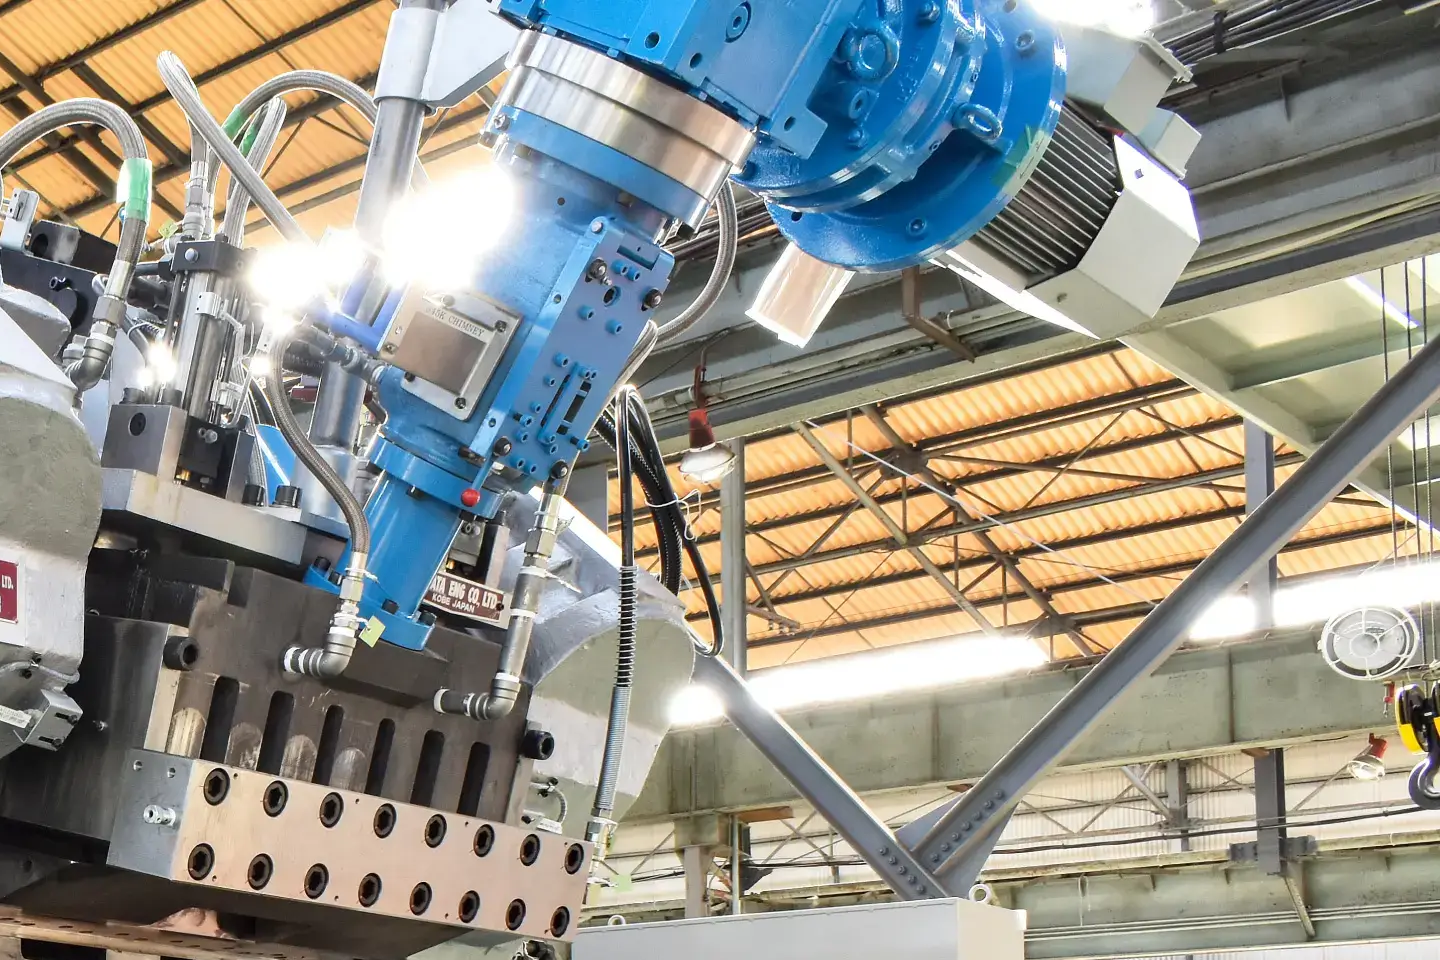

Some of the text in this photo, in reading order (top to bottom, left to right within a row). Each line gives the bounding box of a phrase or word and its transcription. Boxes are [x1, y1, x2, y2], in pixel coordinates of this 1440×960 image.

[448, 315, 485, 338] CHIMNEY
[1, 574, 14, 590] LTD.
[448, 580, 466, 600] ENG
[431, 592, 476, 613] KOBE JAPAN
